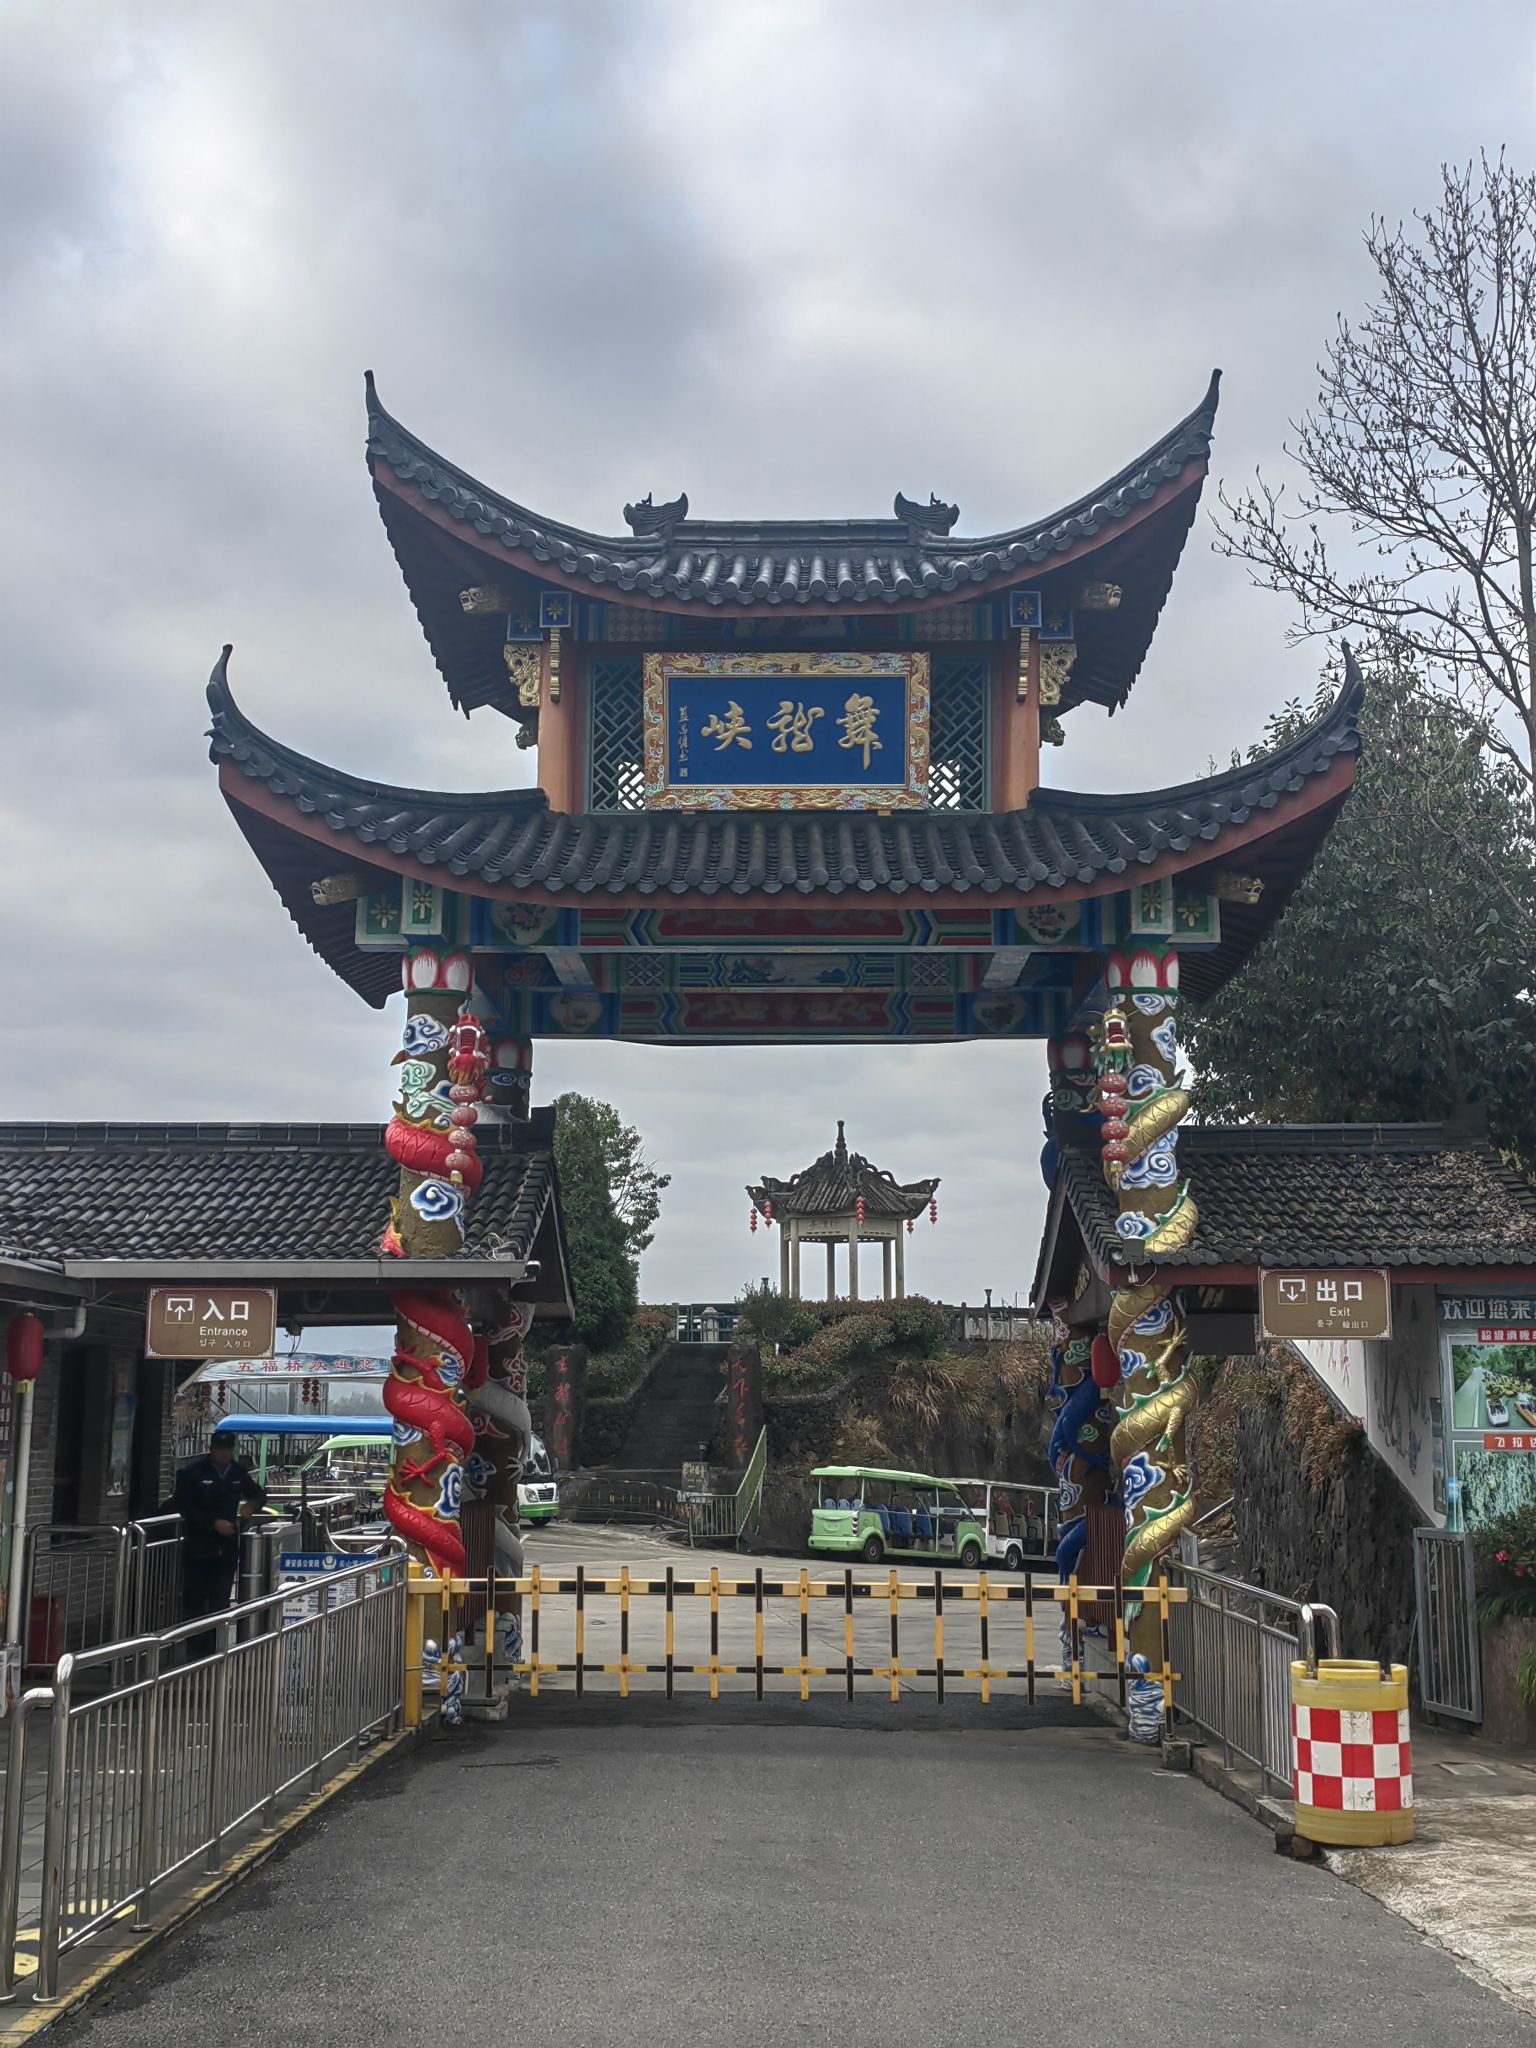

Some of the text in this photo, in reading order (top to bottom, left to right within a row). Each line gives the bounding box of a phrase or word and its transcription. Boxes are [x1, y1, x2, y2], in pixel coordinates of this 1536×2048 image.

[1316, 1279, 1363, 1302] 出口
[202, 1298, 250, 1321] 入口
[1329, 1306, 1351, 1317] Exit
[1442, 1299, 1536, 1320] 欢迎您来
[200, 1326, 248, 1337] Entrance
